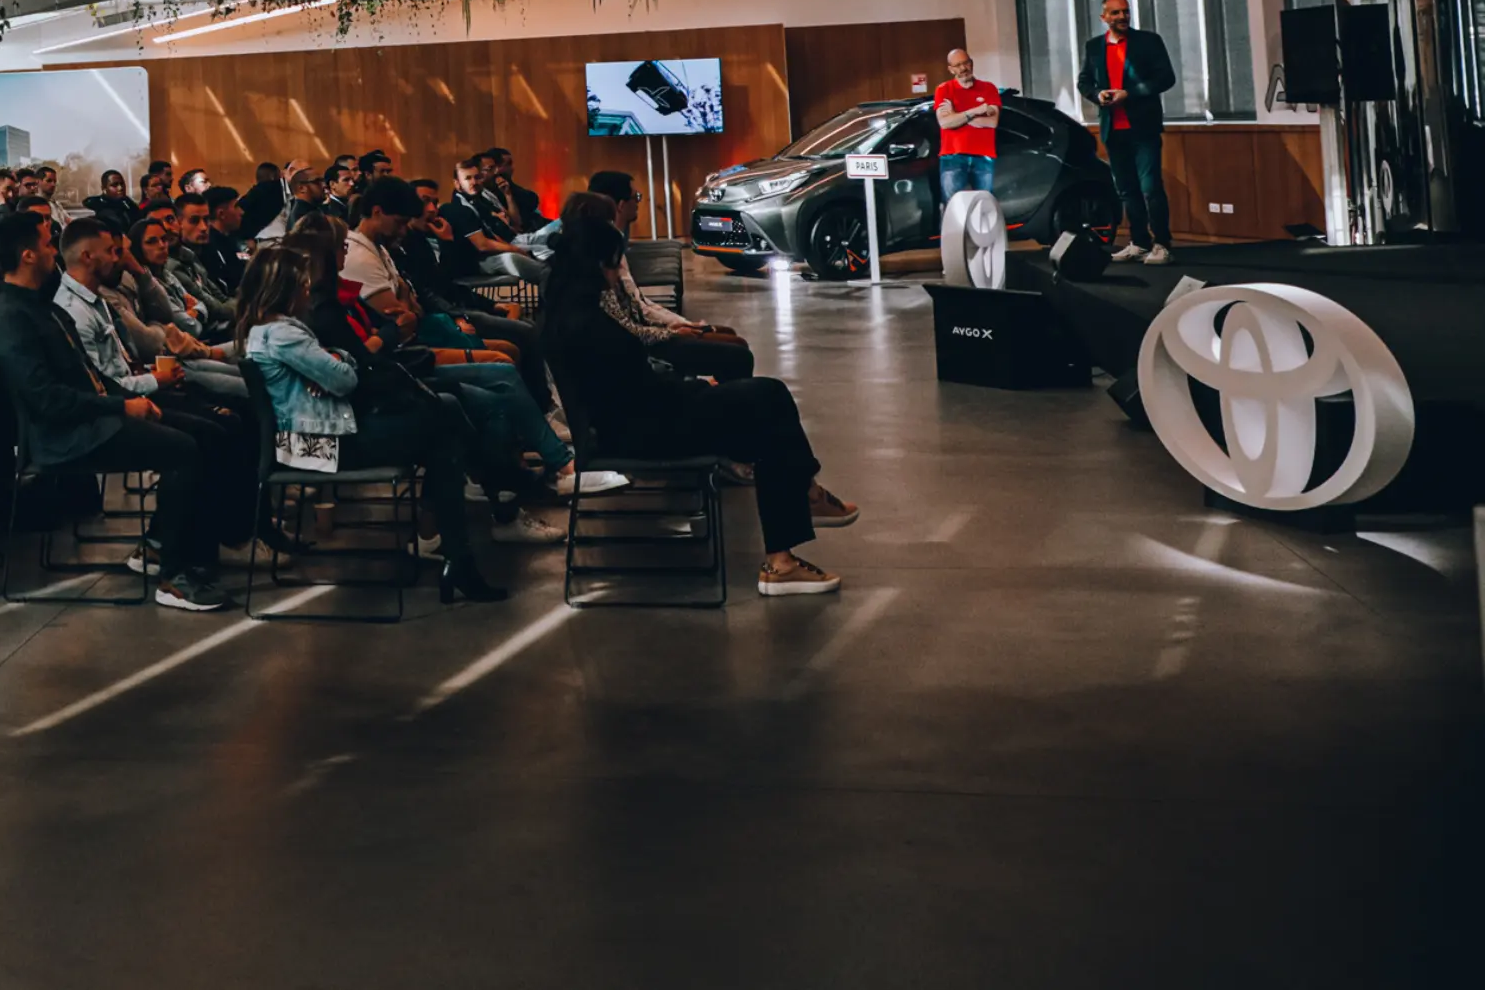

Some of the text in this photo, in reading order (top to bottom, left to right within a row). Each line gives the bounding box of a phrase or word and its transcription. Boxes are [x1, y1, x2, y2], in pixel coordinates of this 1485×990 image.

[855, 161, 879, 171] PARIS
[952, 326, 993, 340] AYGO X
